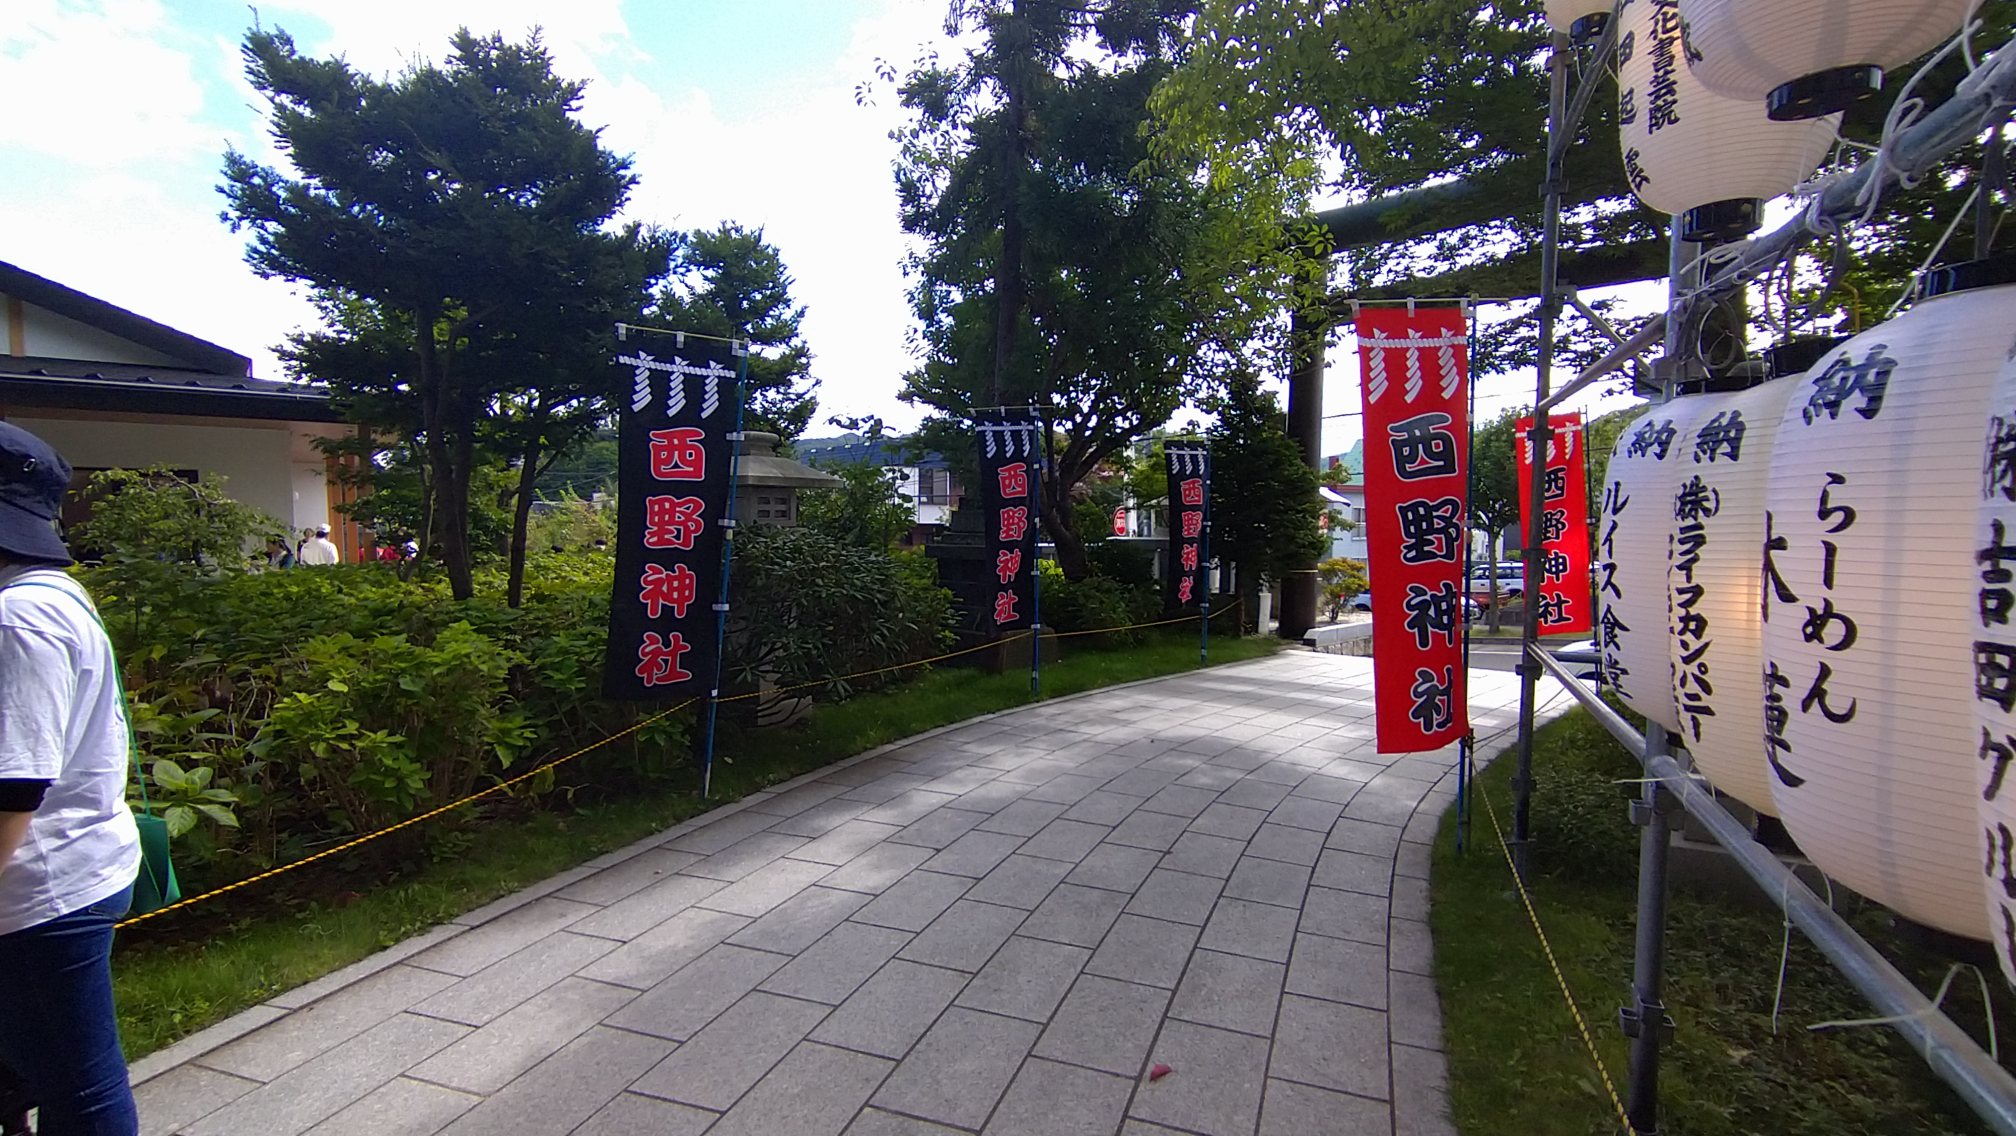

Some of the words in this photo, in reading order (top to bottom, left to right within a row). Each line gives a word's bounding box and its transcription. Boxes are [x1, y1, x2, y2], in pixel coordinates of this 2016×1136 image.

[1627, 419, 1677, 461] 納
[1693, 409, 1747, 463] 納
[1803, 342, 1899, 426] 納
[635, 426, 705, 687] 西野神社
[993, 462, 1028, 625] 西野神社
[1178, 477, 1203, 603] 西野神社
[1387, 412, 1461, 735] 西野神社
[1537, 465, 1574, 626] 西野神社
[1601, 480, 1634, 700] ルイス食堂
[1801, 471, 1858, 724] らーめん
